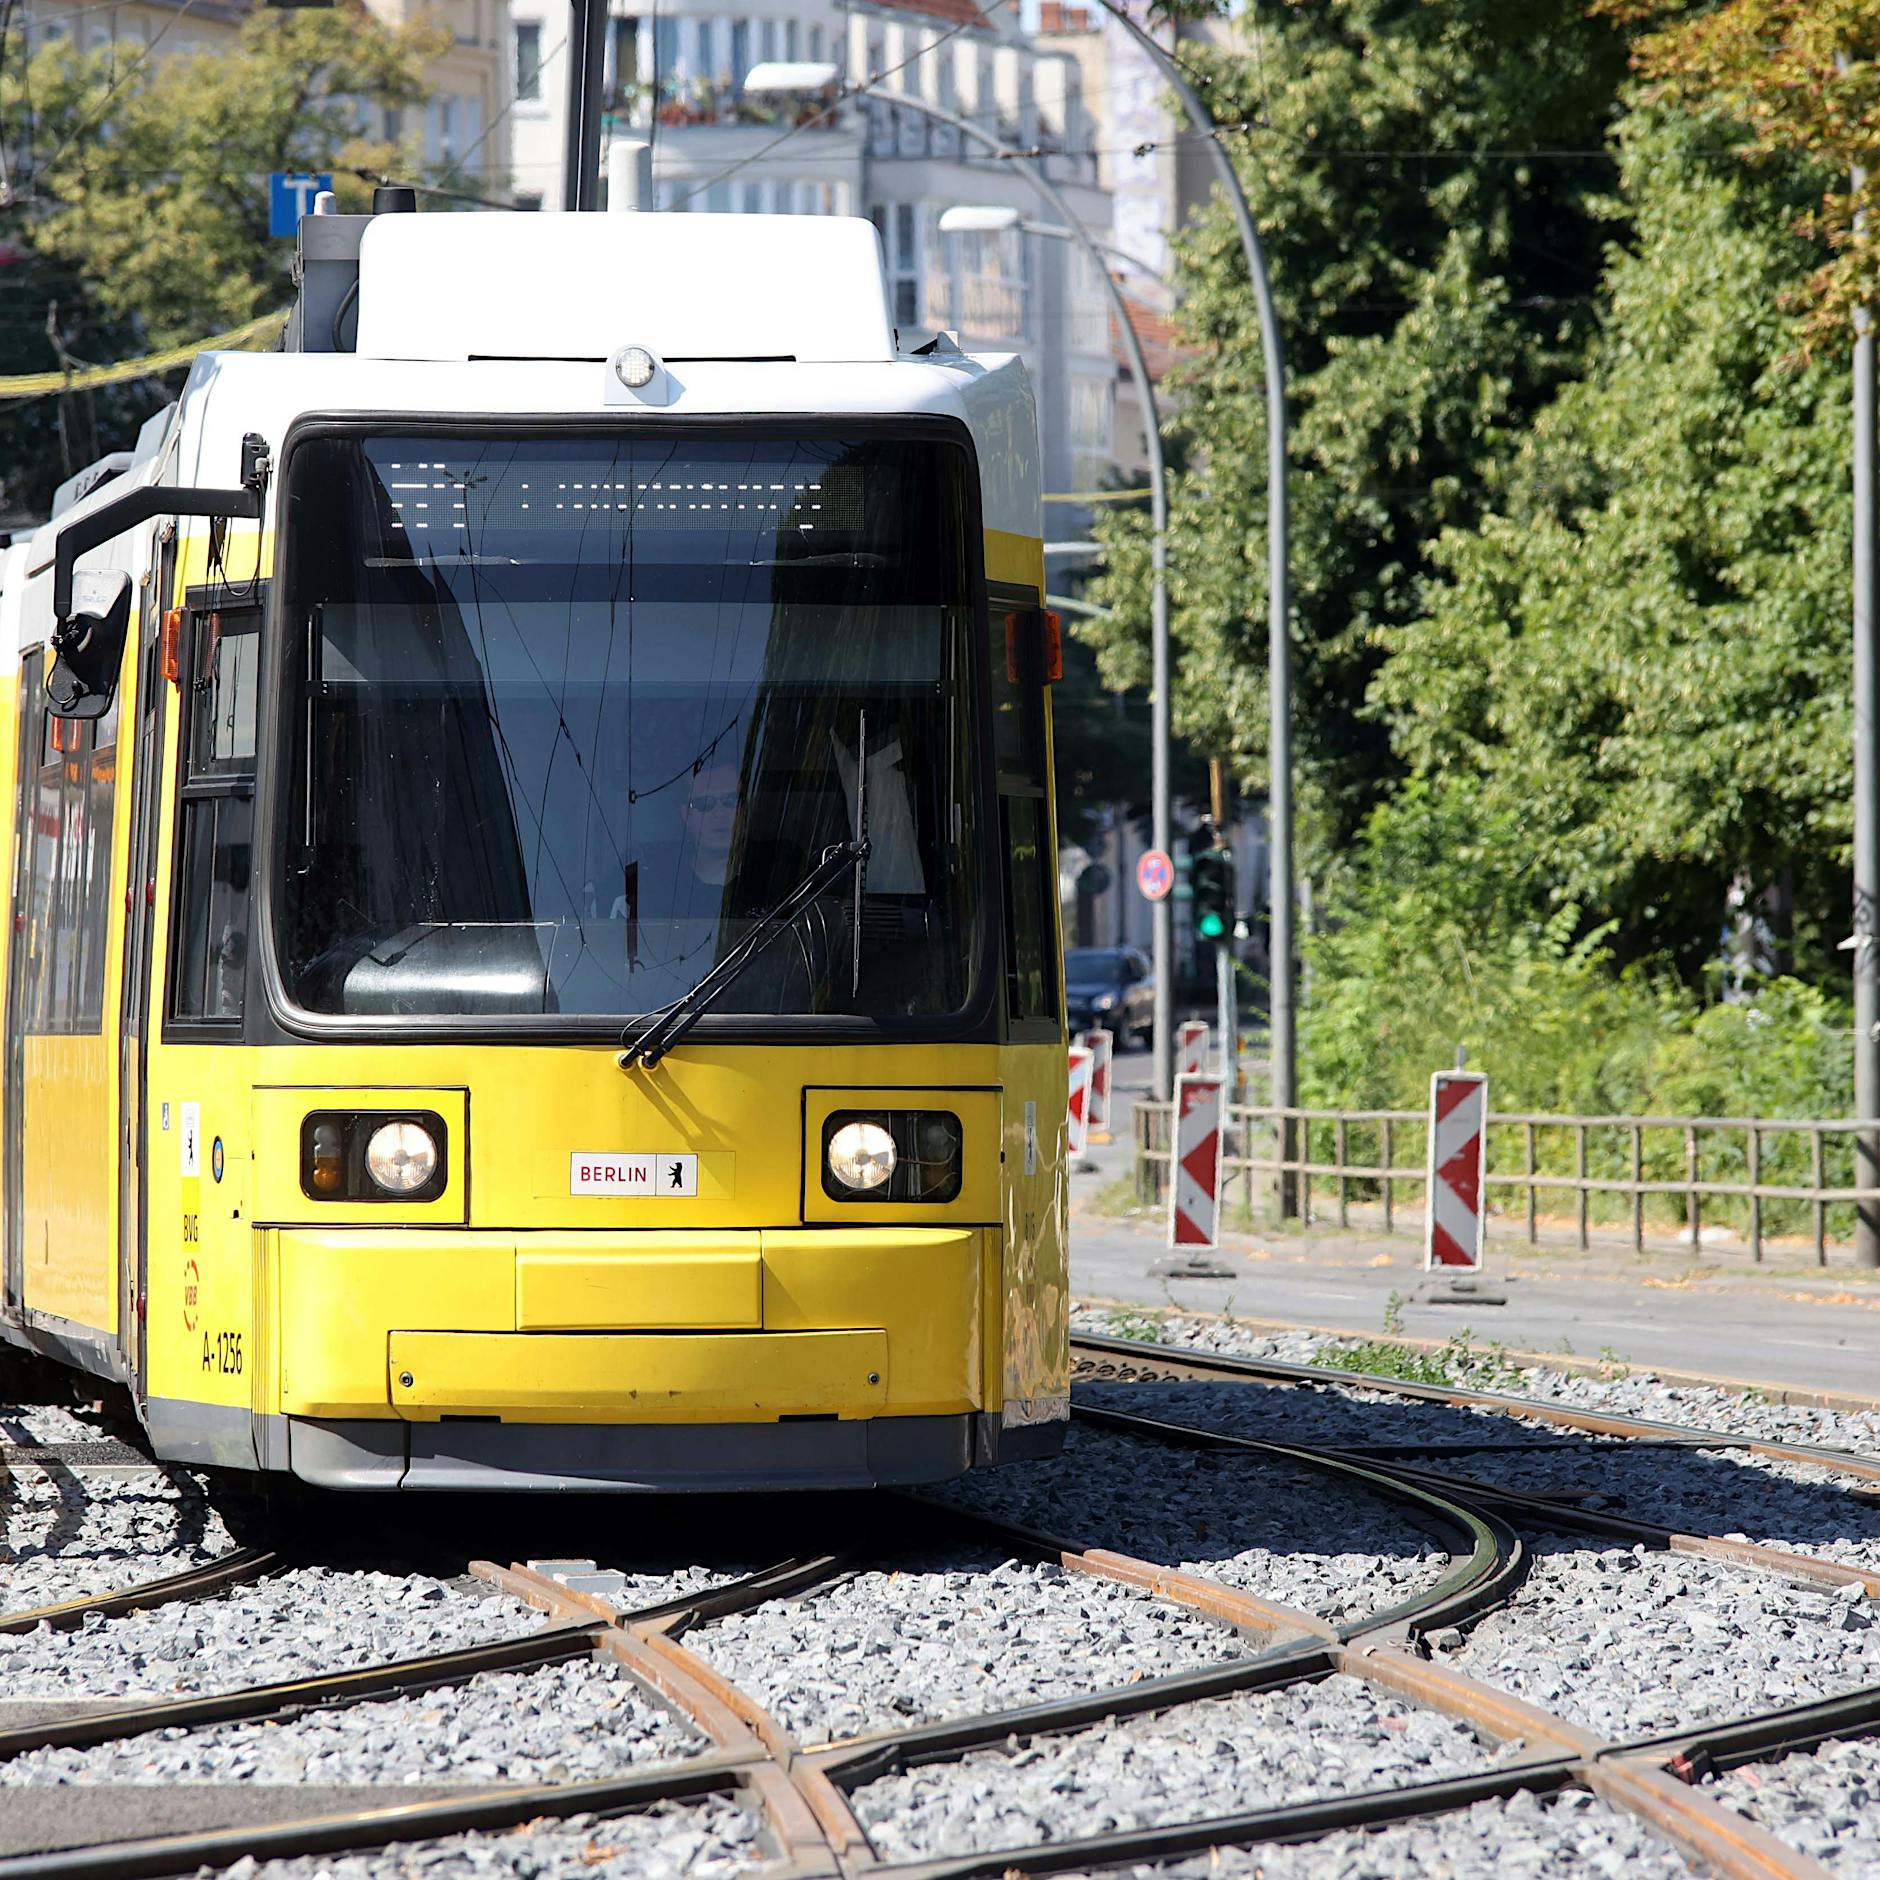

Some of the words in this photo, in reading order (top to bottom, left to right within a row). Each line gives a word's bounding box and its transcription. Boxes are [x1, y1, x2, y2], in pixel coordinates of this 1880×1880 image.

[580, 1166, 647, 1182] BERLIN
[183, 1214, 199, 1242] BVG
[184, 1285, 198, 1306] VBB
[202, 1331, 243, 1374] A-1256
